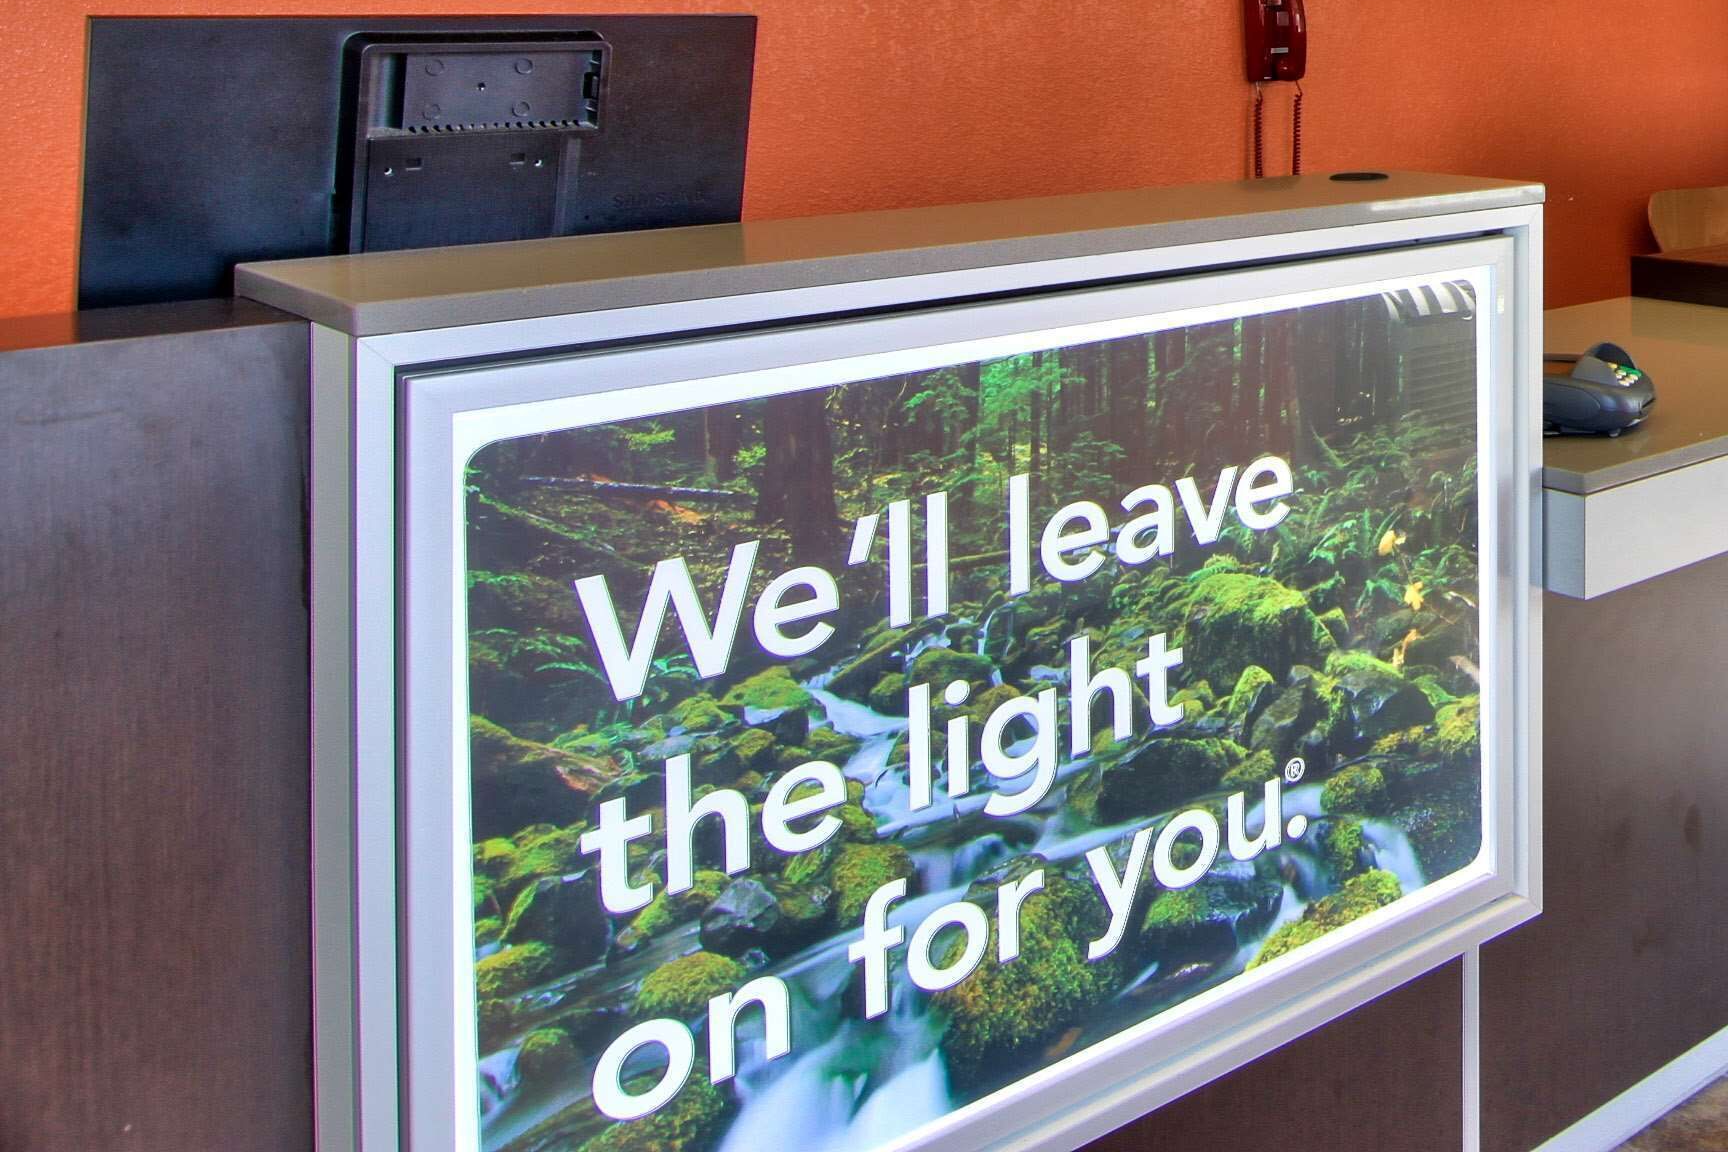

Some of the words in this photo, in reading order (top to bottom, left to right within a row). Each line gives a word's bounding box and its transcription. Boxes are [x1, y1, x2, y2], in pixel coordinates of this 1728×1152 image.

[575, 491, 950, 702] We'll
[1009, 455, 1294, 596] leave
[581, 754, 848, 915] the
[908, 633, 1184, 817] light
[592, 975, 791, 1121] on
[849, 870, 1045, 1019] for
